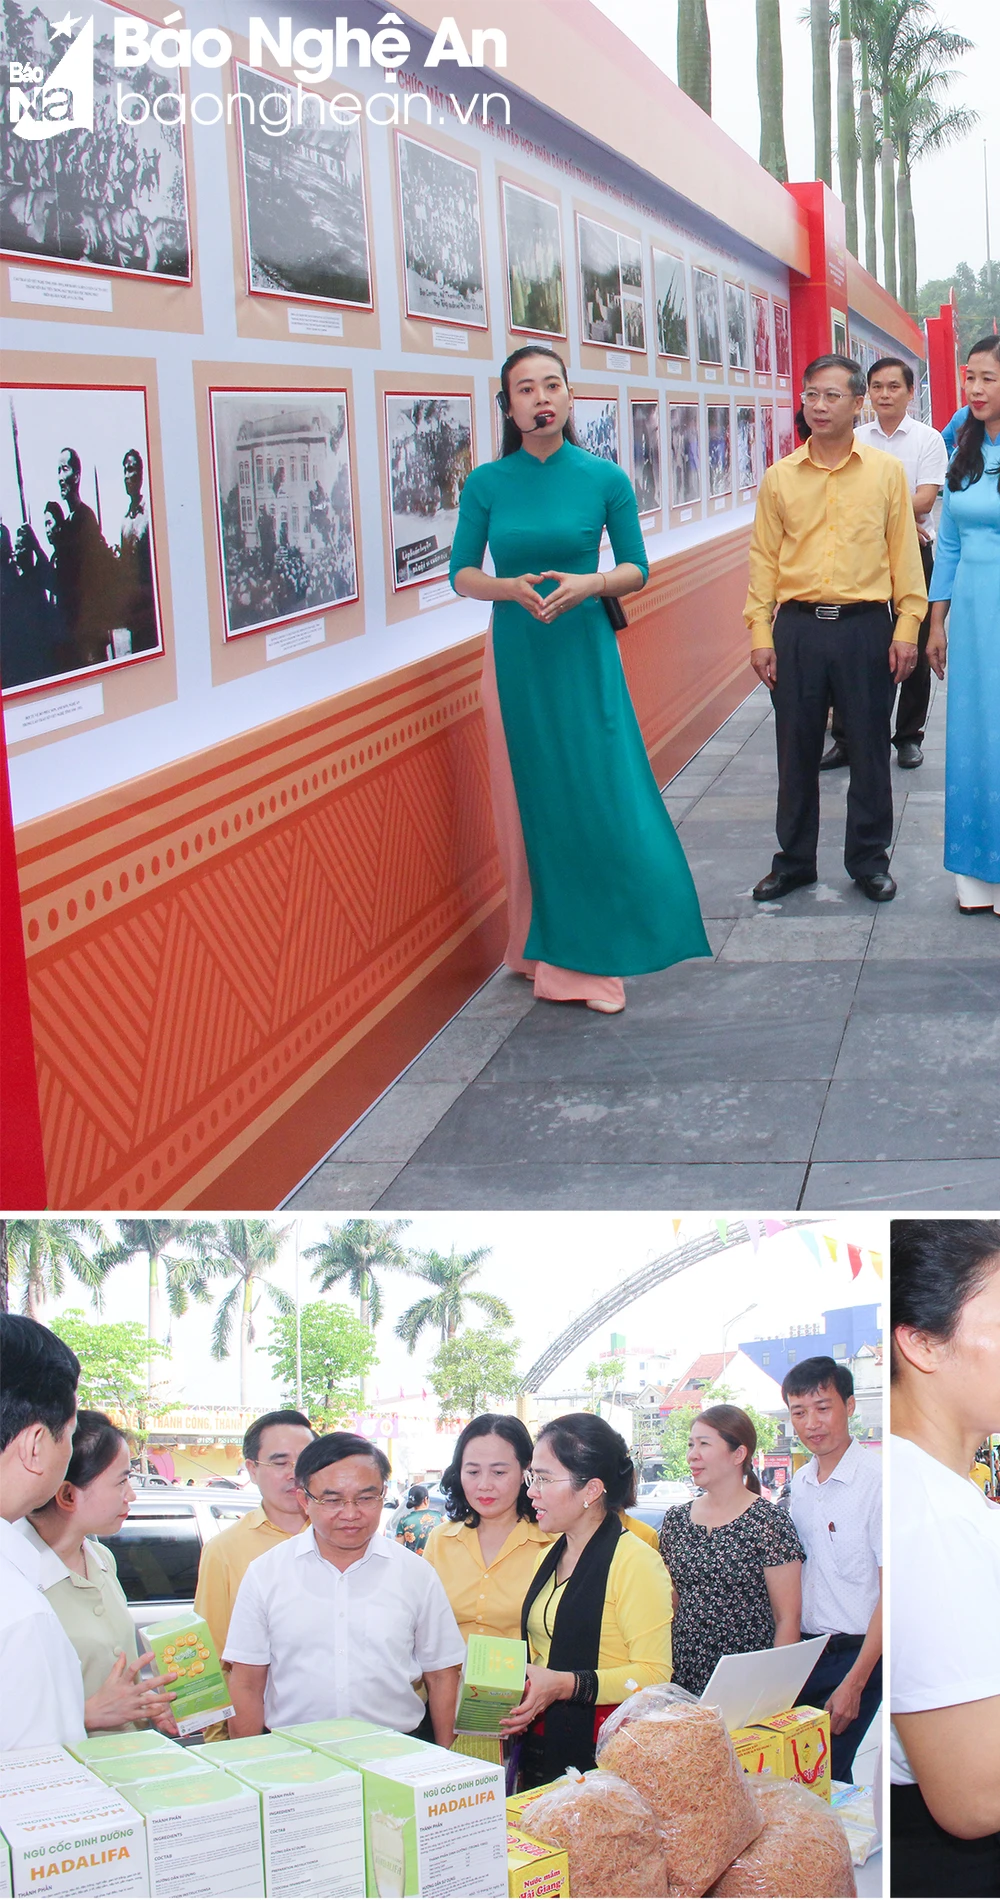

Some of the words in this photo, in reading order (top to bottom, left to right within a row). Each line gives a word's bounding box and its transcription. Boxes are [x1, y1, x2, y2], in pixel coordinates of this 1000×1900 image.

[424, 1787, 439, 1798] NGŨ
[440, 1783, 456, 1794] CỐC
[458, 1780, 474, 1791] DINH
[476, 1775, 498, 1786] DƯỠNG
[269, 1808, 295, 1816] INGREDIENTS
[428, 1790, 495, 1817] HADALIFA
[24, 1848, 45, 1860] NGŨ
[49, 1840, 72, 1854] CỐC
[74, 1837, 98, 1848] DINH
[100, 1828, 134, 1842] DƯỠNG
[153, 1833, 182, 1842] INGREDIENTS
[30, 1846, 130, 1881] HADALIFA
[524, 1878, 542, 1888] Nước
[544, 1869, 560, 1880] mắm
[18, 1889, 38, 1898] THÀNH
[38, 1885, 52, 1893] PHẦN
[520, 1890, 534, 1898] Hải
[536, 1881, 561, 1896] Giang
